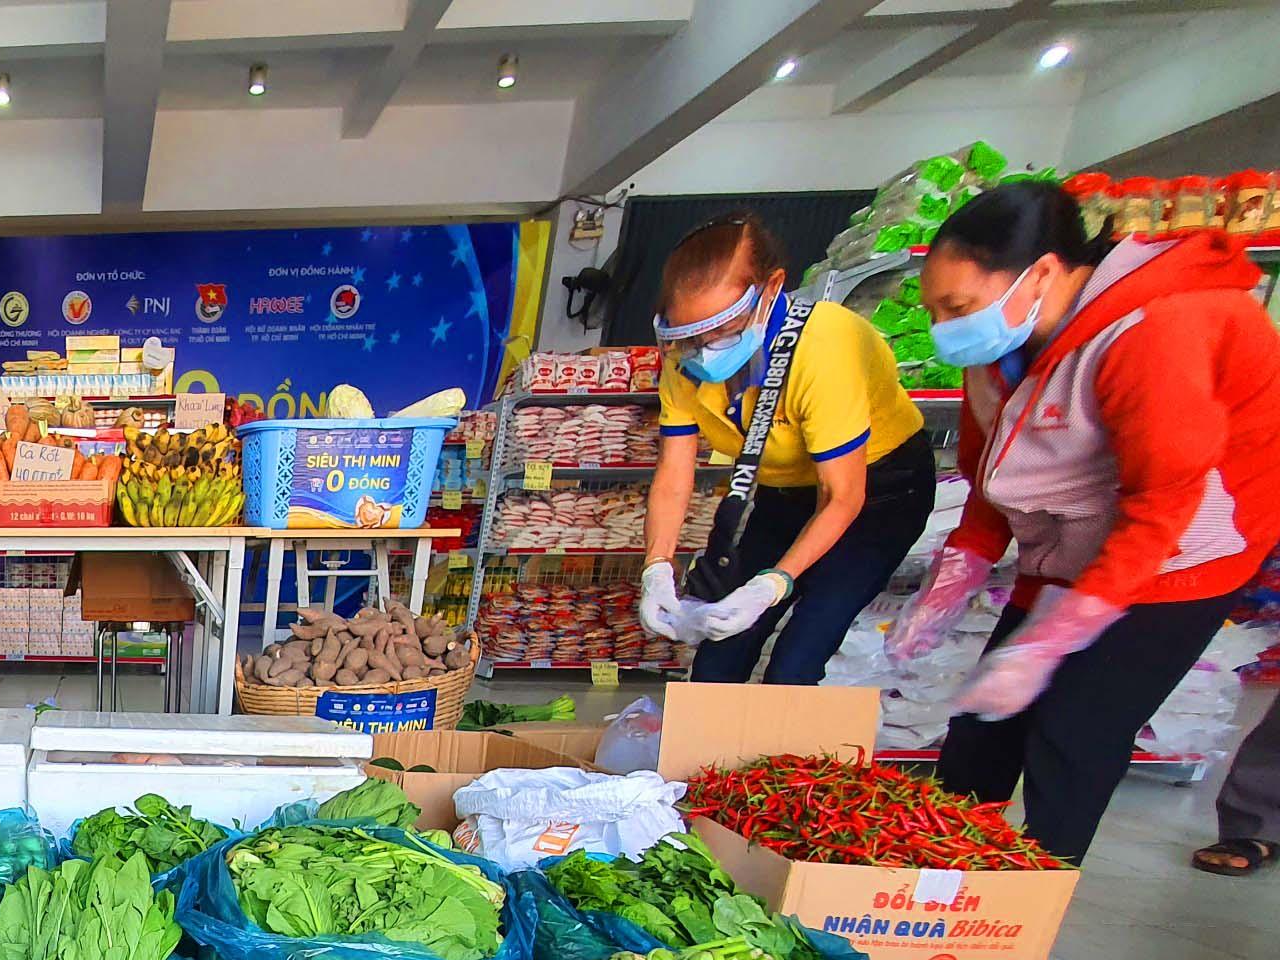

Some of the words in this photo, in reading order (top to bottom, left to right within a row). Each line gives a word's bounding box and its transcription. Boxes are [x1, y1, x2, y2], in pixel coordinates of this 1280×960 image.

[144, 297, 170, 316] PNJ
[249, 296, 304, 314] HAWEE
[306, 452, 339, 468] SIÊU
[343, 454, 367, 470] THỊ
[370, 454, 401, 468] MINI
[326, 469, 345, 492] 0
[348, 472, 390, 490] ĐỒNG
[397, 718, 427, 733] MINI
[823, 913, 891, 938] NHẬN
[894, 917, 945, 938] QUÀ
[947, 918, 1024, 938] Bibica
